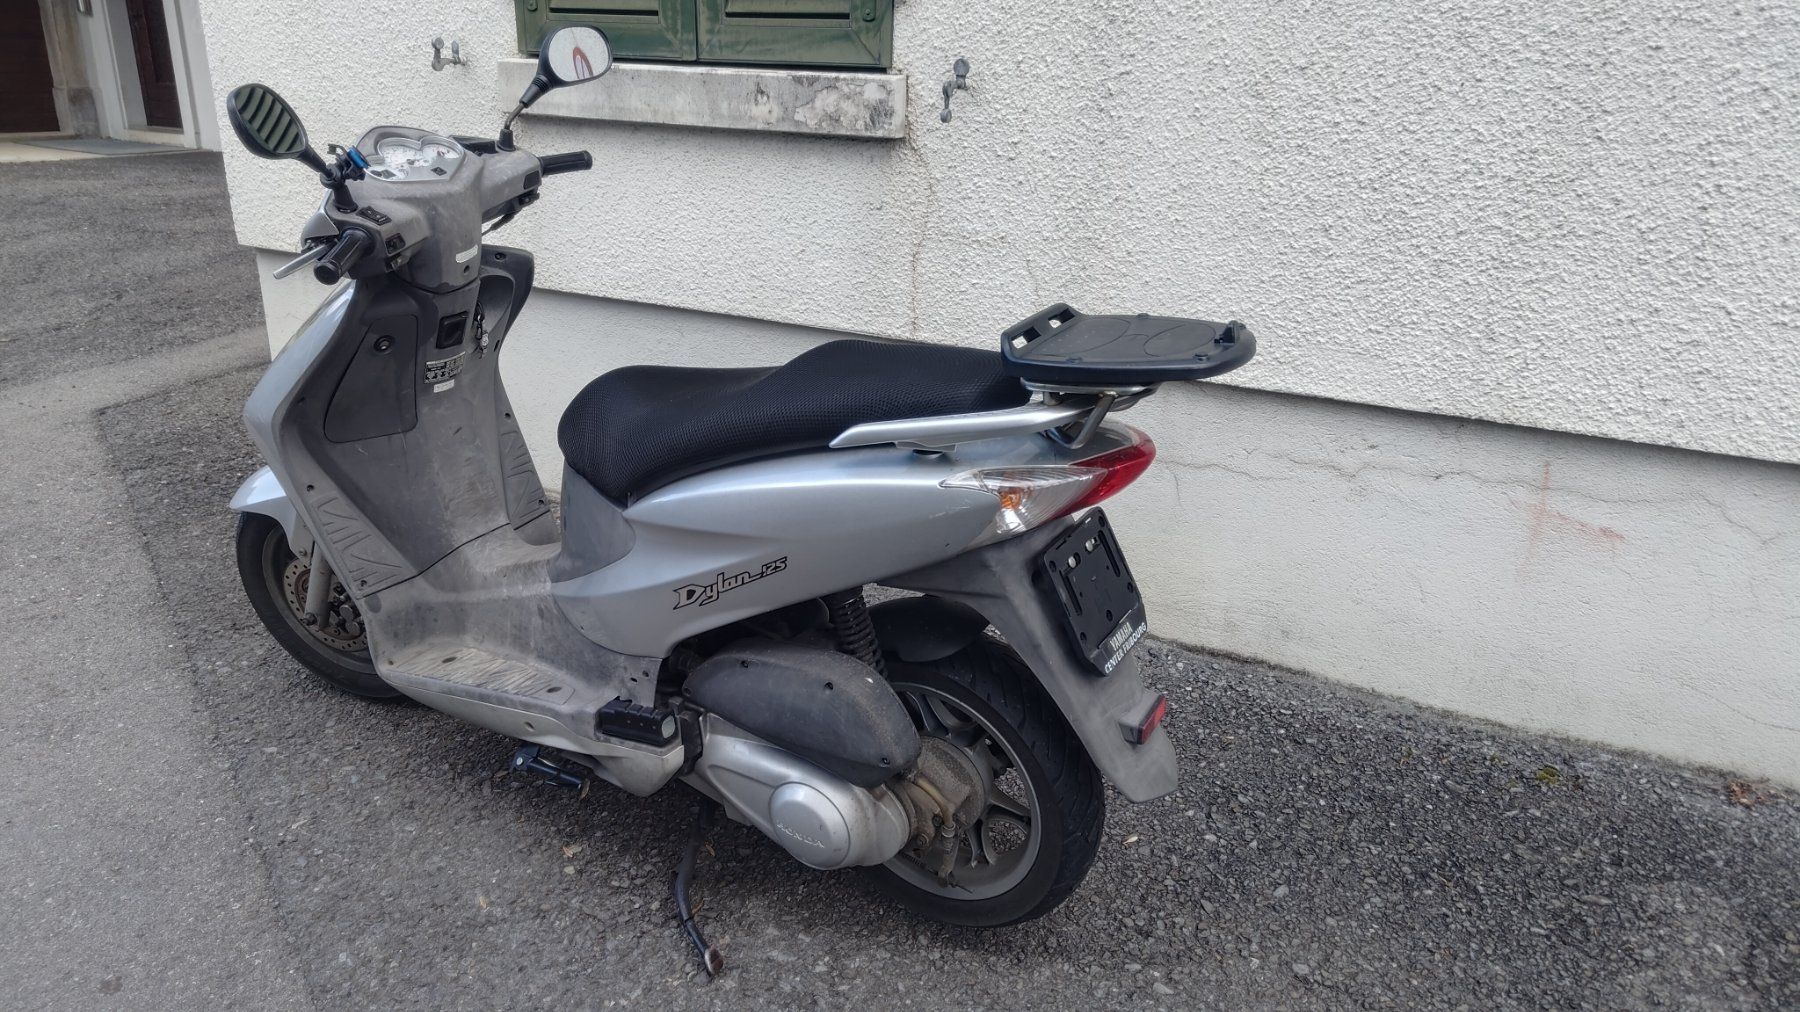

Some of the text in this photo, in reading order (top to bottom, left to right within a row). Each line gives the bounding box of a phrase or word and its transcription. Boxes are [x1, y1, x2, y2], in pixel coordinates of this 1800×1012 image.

[673, 556, 788, 610] Dylan 125
[1104, 622, 1146, 673] CENTER FRIBOURG
[1109, 622, 1133, 651] YAMAHA
